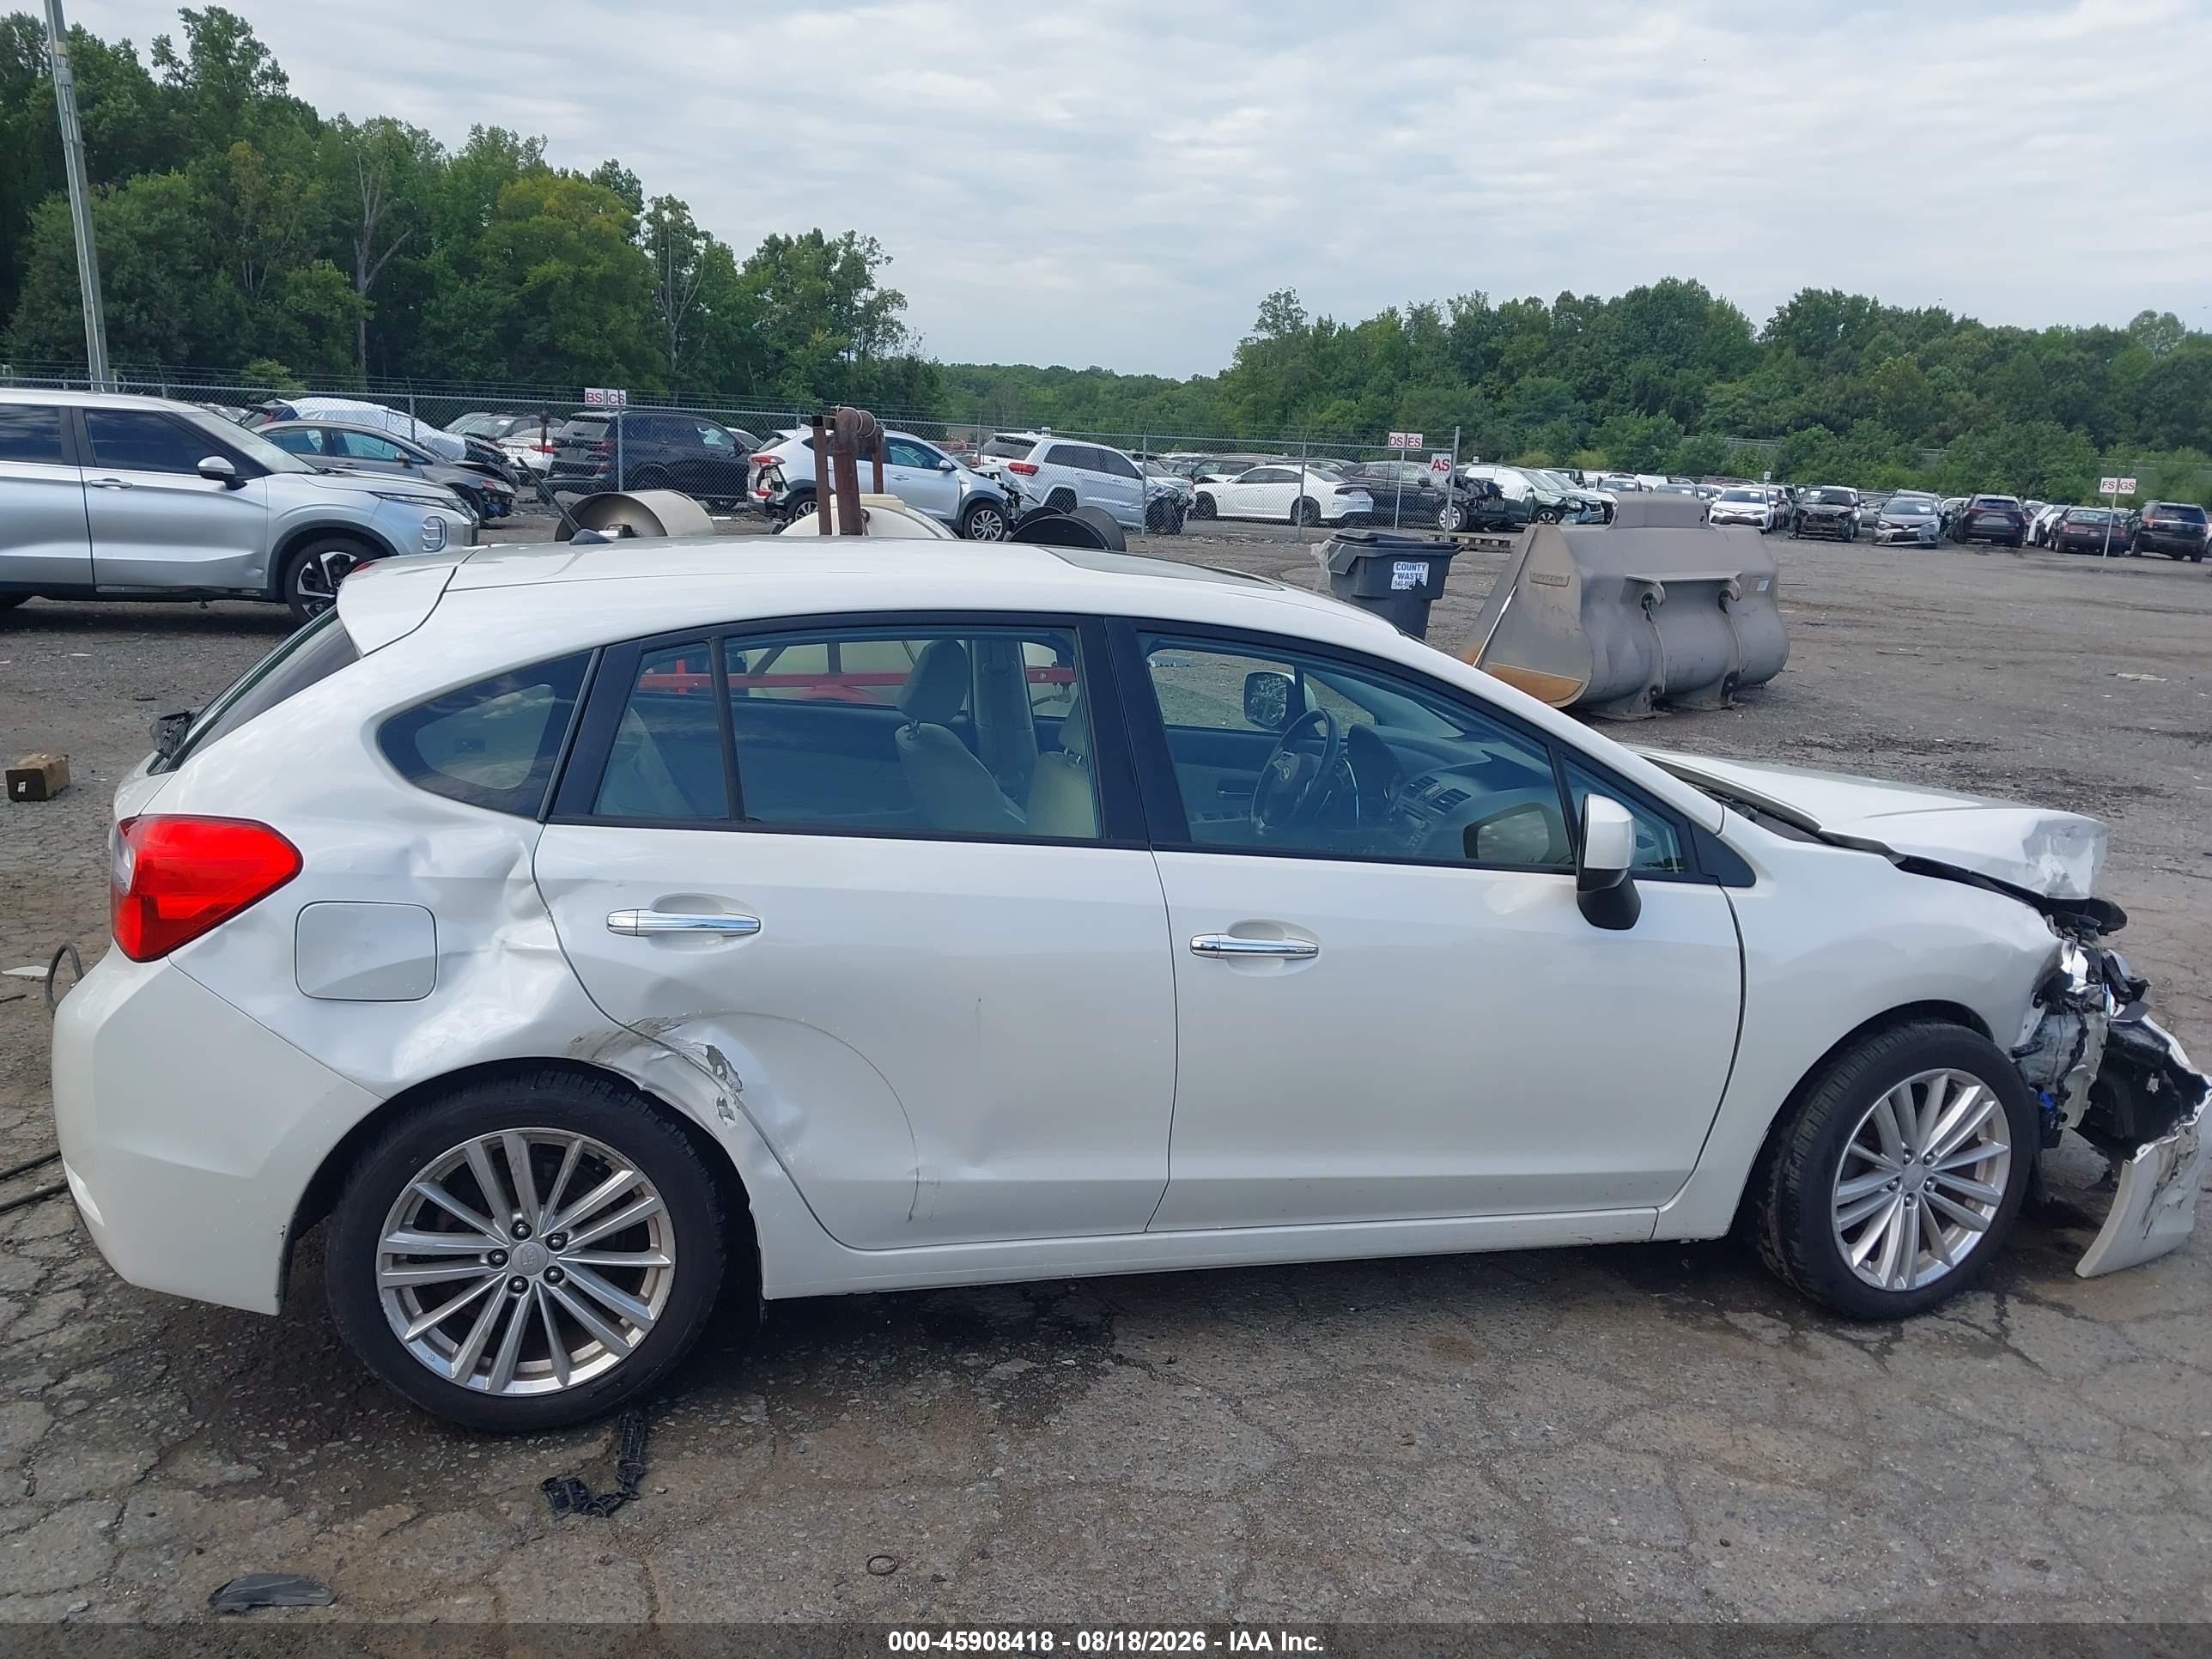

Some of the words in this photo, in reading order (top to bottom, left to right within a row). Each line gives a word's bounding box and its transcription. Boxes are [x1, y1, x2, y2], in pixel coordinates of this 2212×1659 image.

[586, 392, 603, 403] BS
[609, 393, 625, 404] CS
[1389, 436, 1403, 447] DS
[1407, 437, 1421, 447] ES
[1431, 459, 1450, 471] AS
[2101, 481, 2115, 489] FS
[2120, 482, 2136, 490] GS
[1396, 562, 1426, 572] COUNTY
[1397, 572, 1424, 580] WASTE
